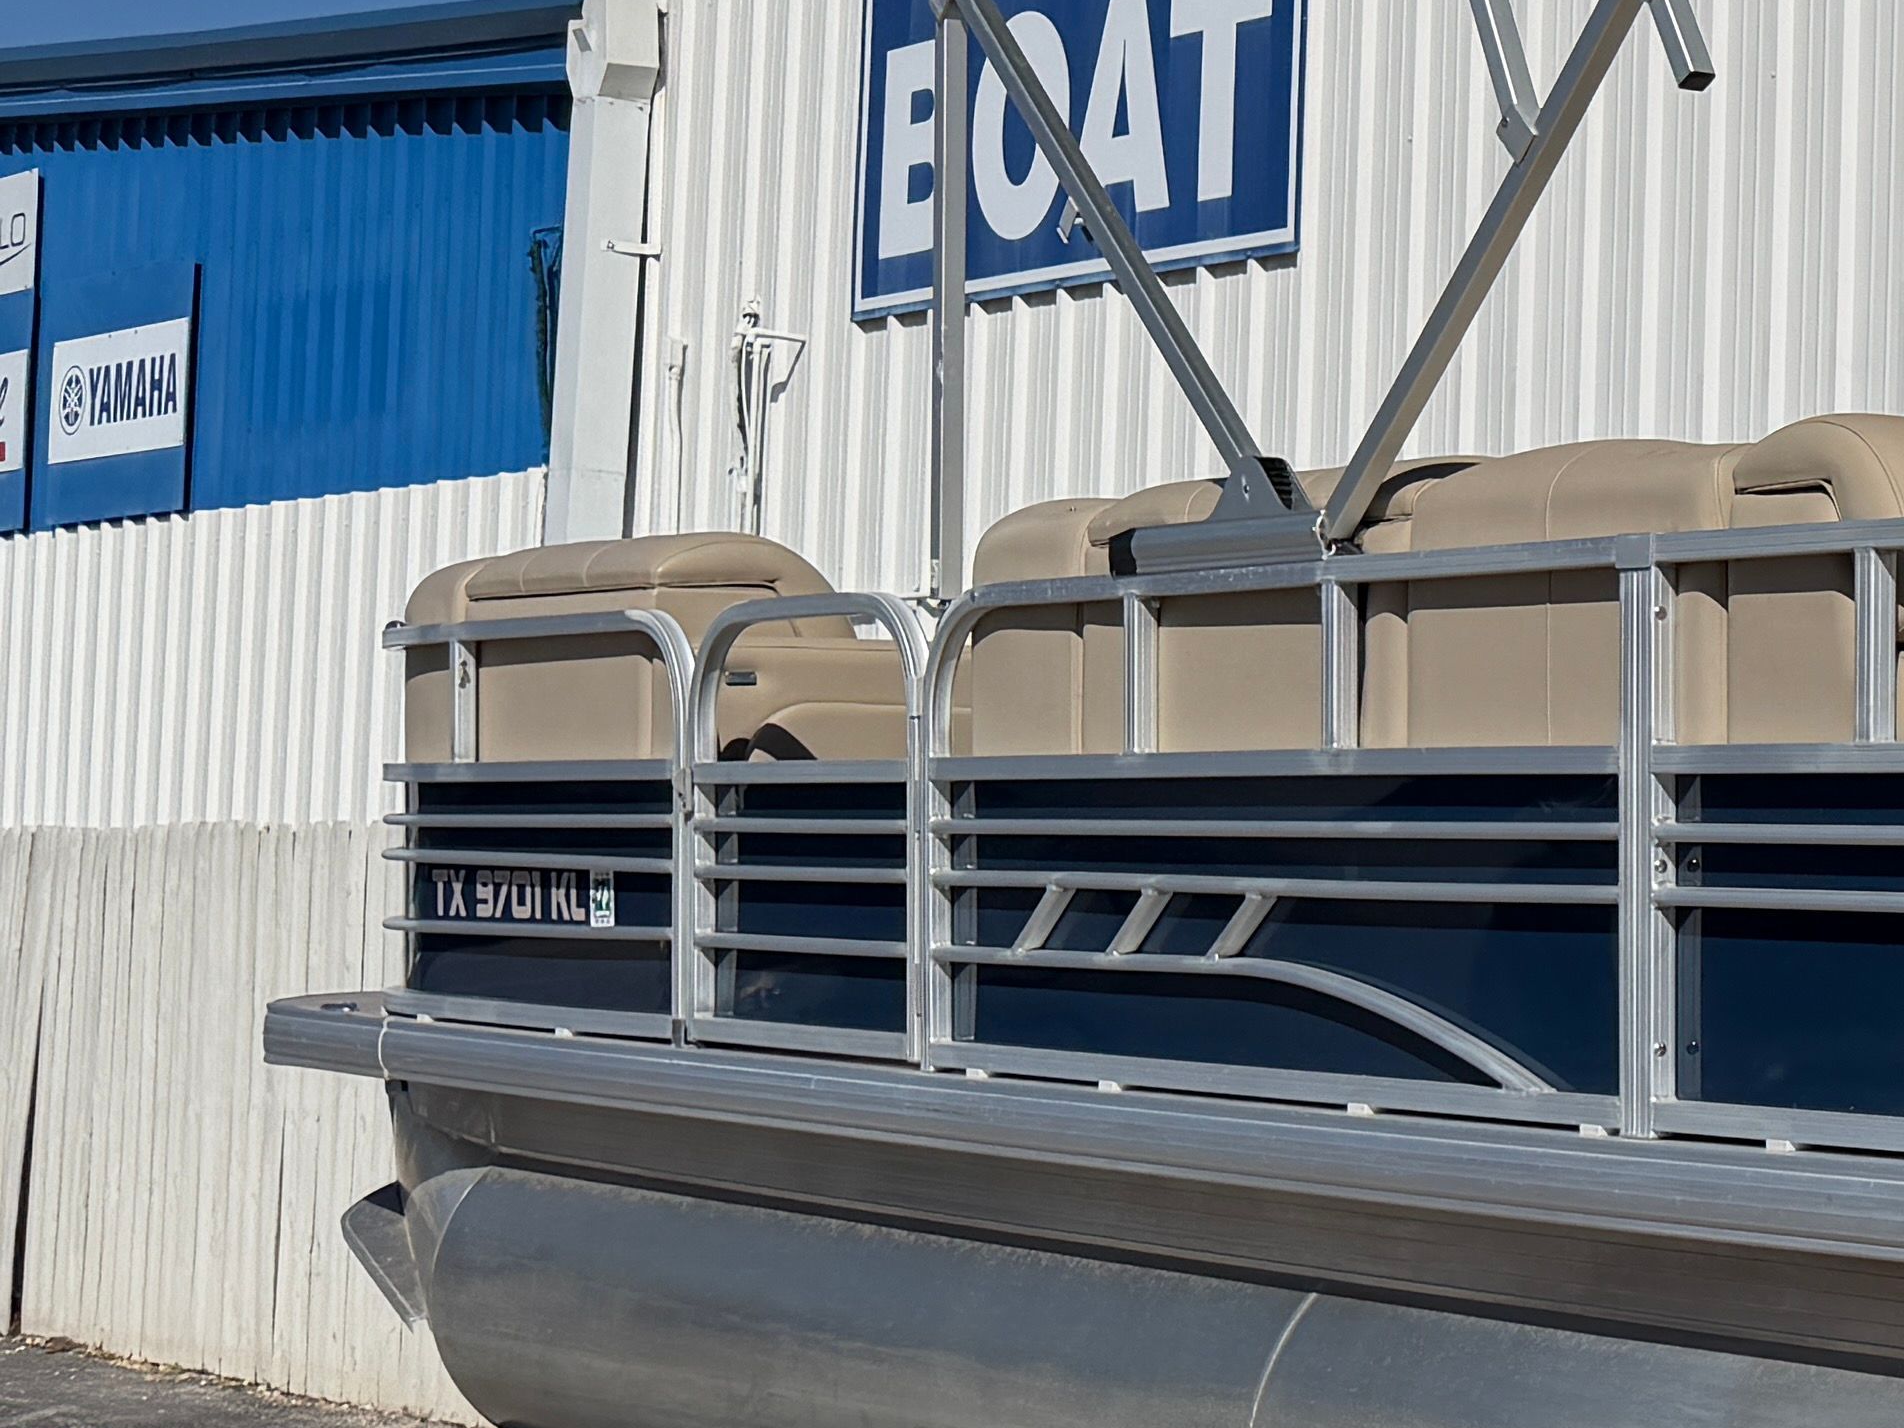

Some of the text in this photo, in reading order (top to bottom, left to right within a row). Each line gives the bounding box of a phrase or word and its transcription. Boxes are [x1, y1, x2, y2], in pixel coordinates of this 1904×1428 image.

[89, 352, 178, 427] YAMAHA
[431, 869, 467, 917] TX
[475, 869, 542, 920] 9701
[550, 871, 587, 922] KL
